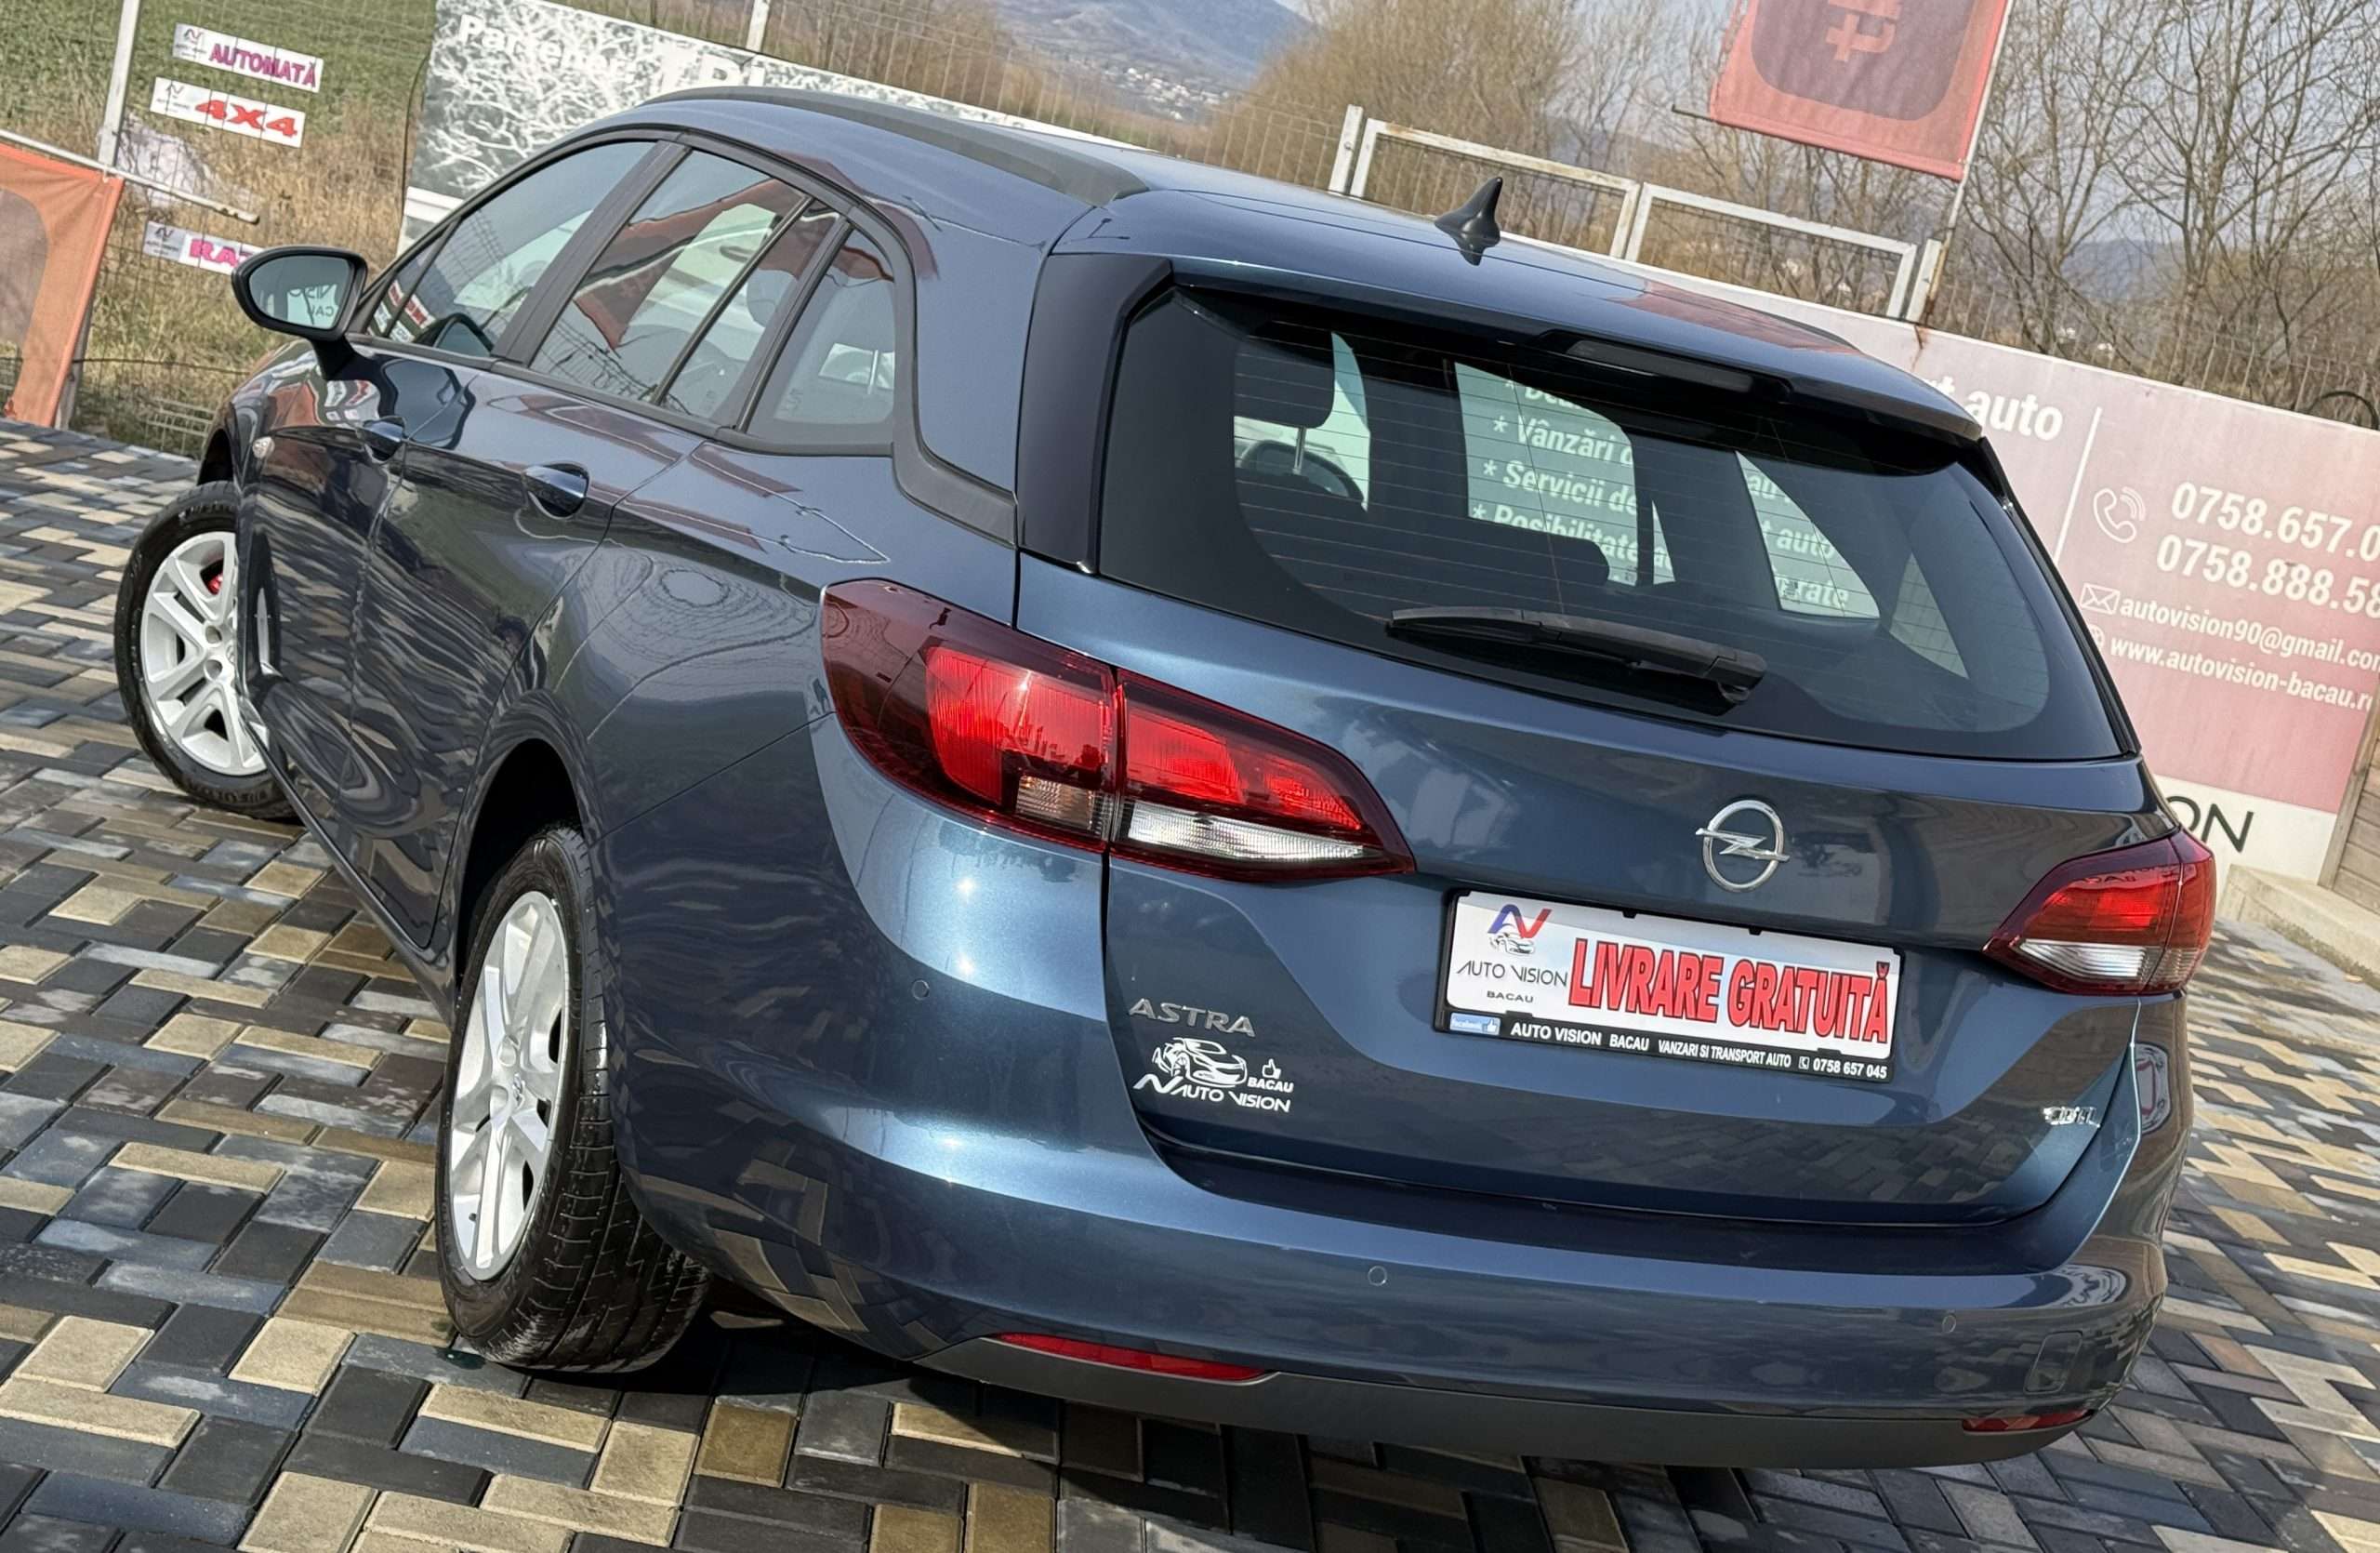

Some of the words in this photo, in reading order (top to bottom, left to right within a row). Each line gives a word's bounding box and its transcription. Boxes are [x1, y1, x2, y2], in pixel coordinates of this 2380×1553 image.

[209, 44, 317, 87] AUTOMATĂ
[1966, 391, 2063, 441] auto
[1517, 415, 1615, 461] Vânzări
[1502, 460, 1606, 508] Servicii
[1457, 960, 1505, 979] AUTO
[1510, 964, 1568, 988] VISION
[1568, 937, 1725, 1023] LIVRARE
[1727, 962, 1890, 1043] GRATUITĂ
[1129, 998, 1255, 1038] ASTRA
[1487, 990, 1534, 1003] BACAU
[1511, 1022, 1552, 1040] AUTO
[1554, 1027, 1602, 1046] VISION
[1609, 1033, 1650, 1052] BACAU
[1658, 1039, 1698, 1057] VANZARI
[1699, 1045, 1710, 1058] SI
[1711, 1047, 1765, 1067] TRANSPORT
[1766, 1053, 1792, 1069] AUTO
[1813, 1058, 1841, 1073] 0758
[1844, 1063, 1865, 1077] 657
[1867, 1066, 1887, 1080] 045
[1170, 1084, 1224, 1103] AUTO
[1228, 1091, 1291, 1113] VISION
[1247, 1077, 1294, 1094] BACAU
